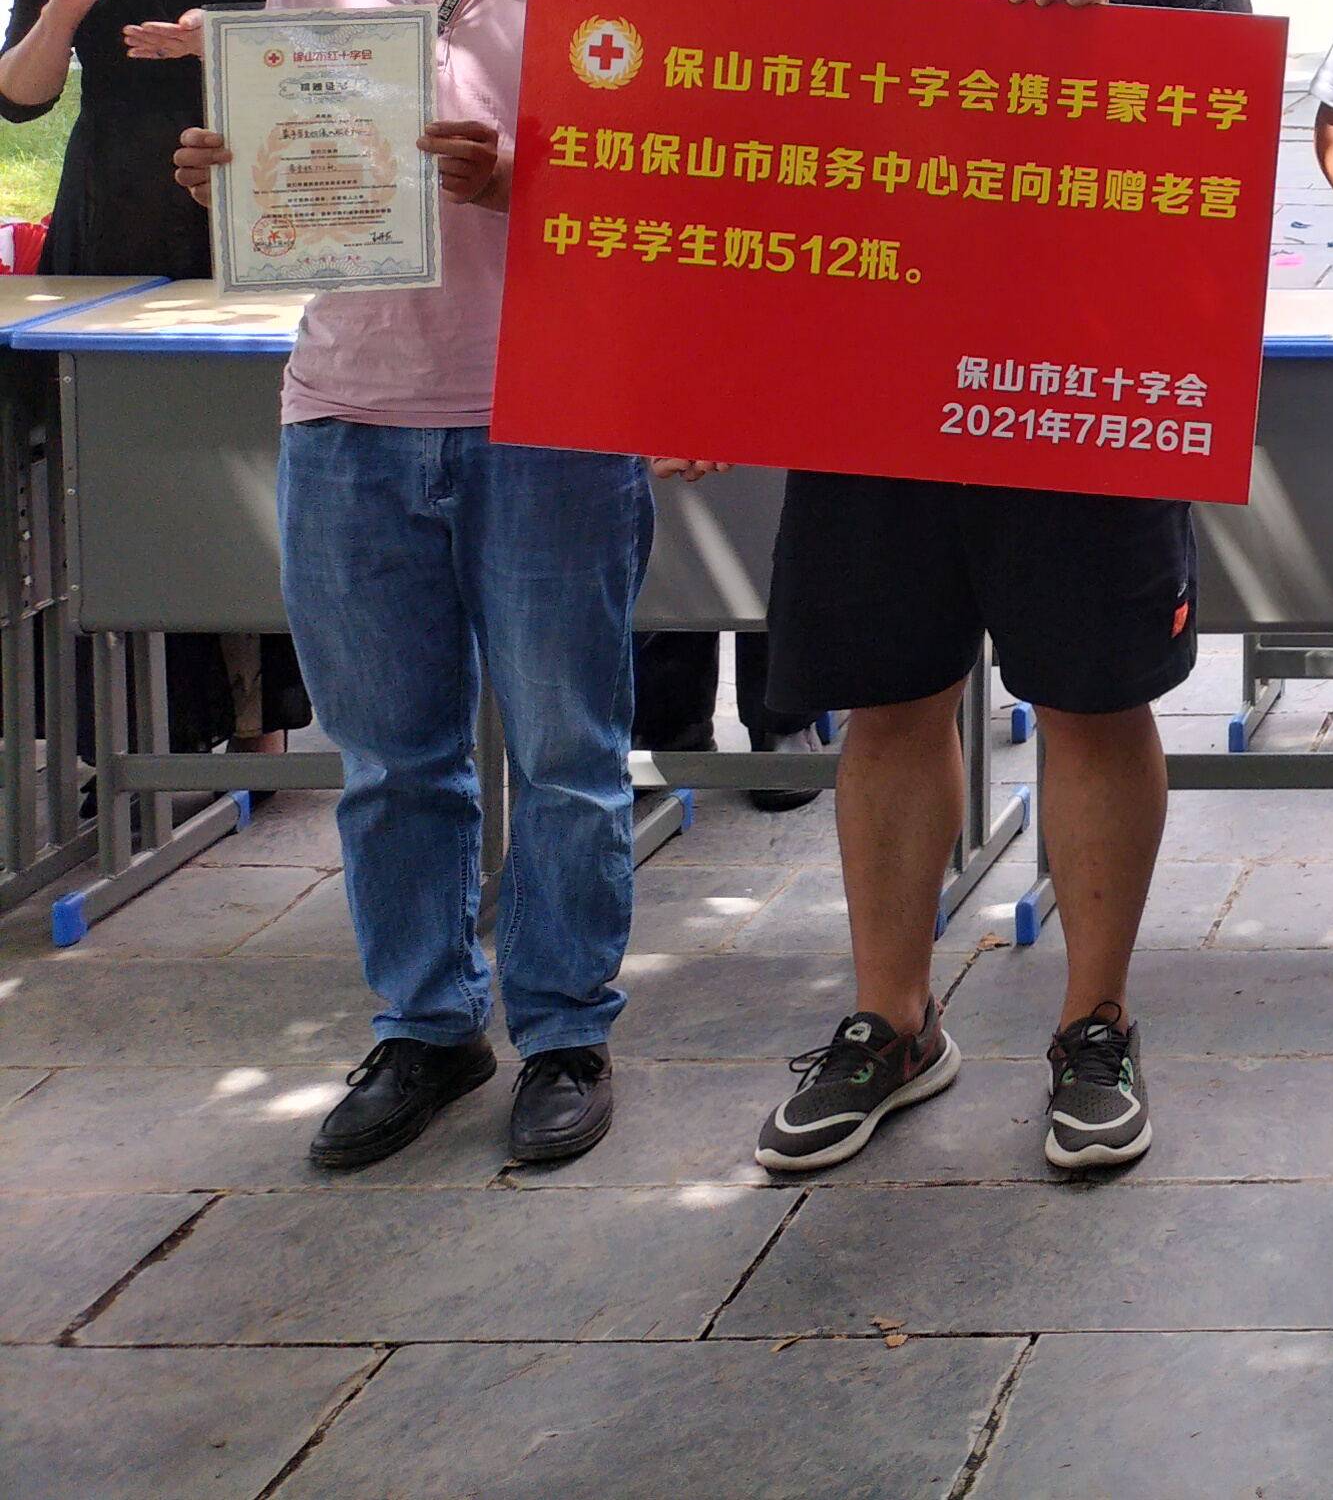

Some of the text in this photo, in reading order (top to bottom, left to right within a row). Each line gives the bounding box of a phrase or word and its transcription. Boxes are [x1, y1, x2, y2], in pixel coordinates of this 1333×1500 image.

[663, 46, 1249, 132] 保山市红十字会携手蒙牛学
[548, 125, 1242, 220] 生奶保山市服务中心定向捐赠老营
[543, 210, 924, 285] 中学学生奶512瓶。
[956, 355, 1209, 408] 保山市红十字会
[939, 402, 1213, 457] 2021年7月26日
